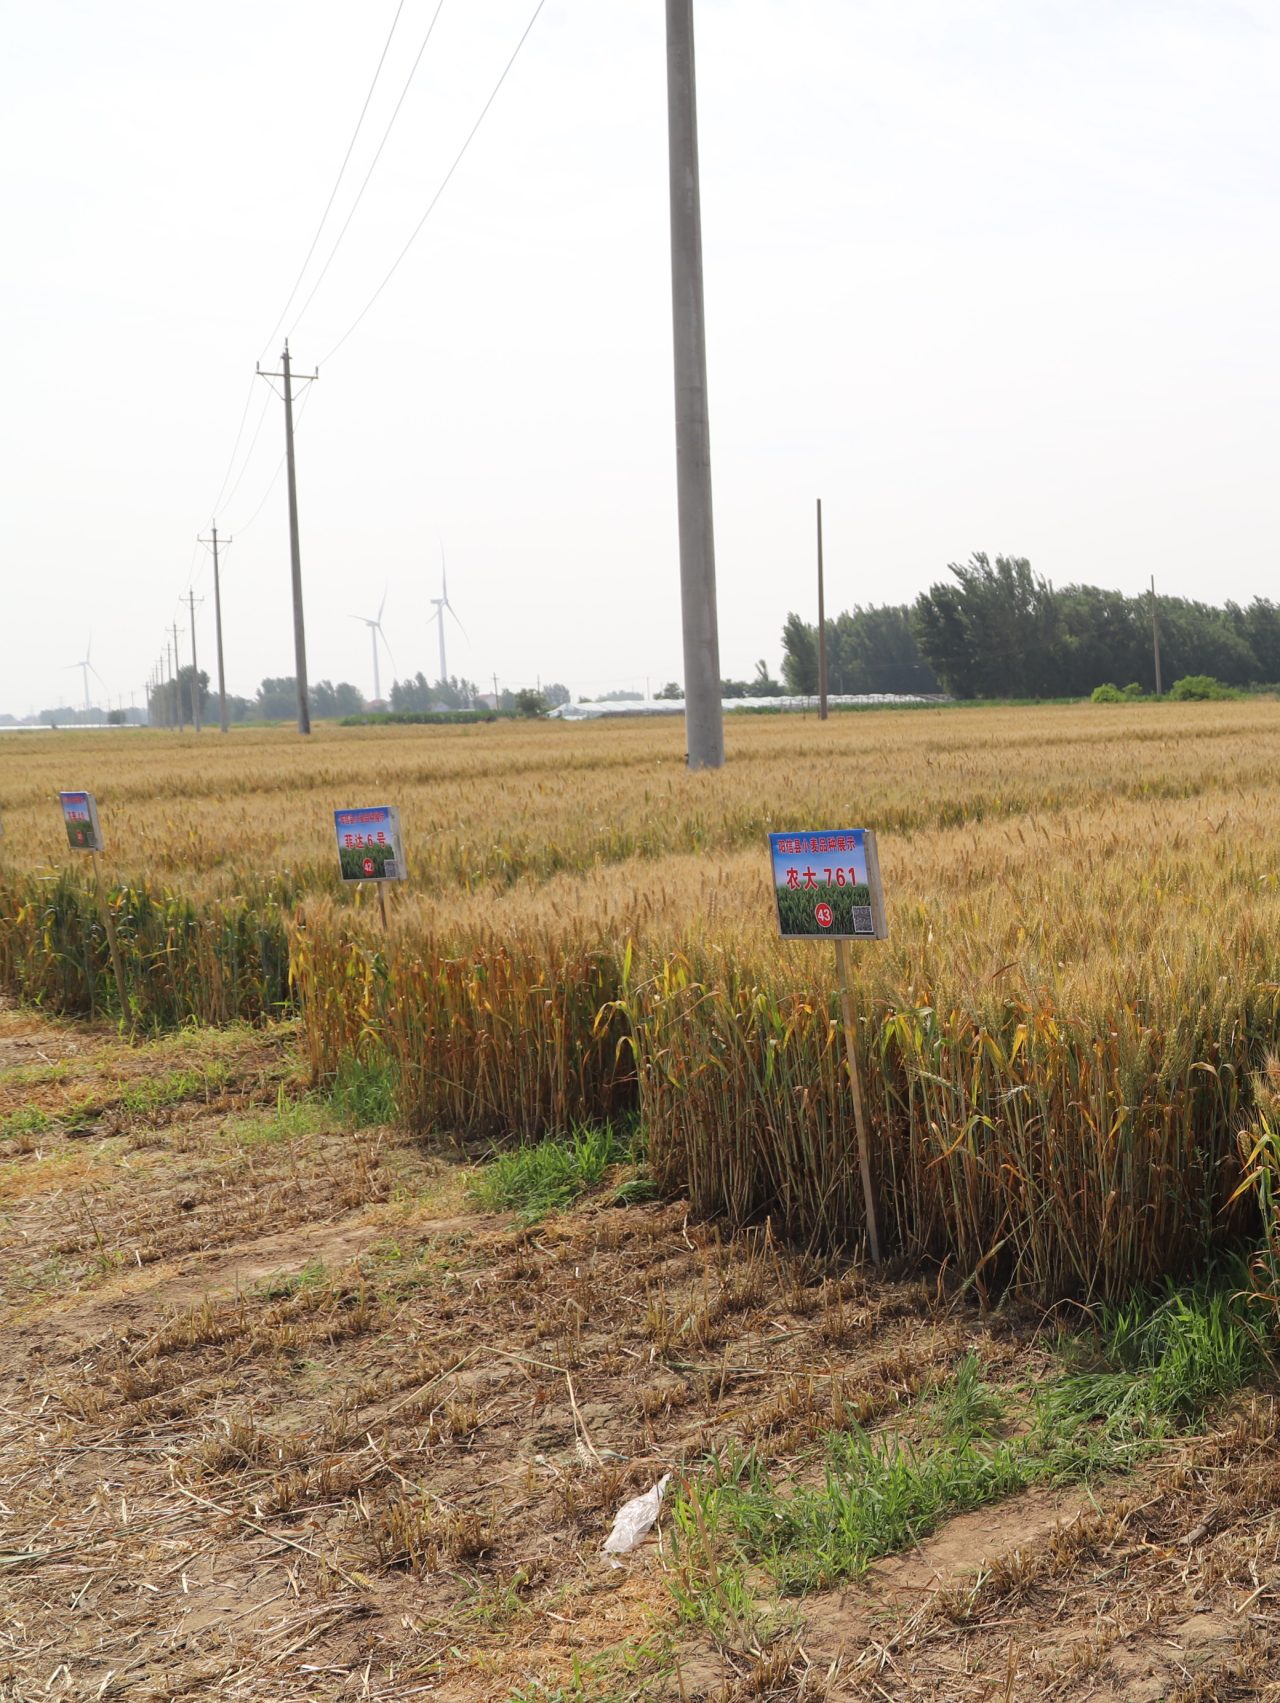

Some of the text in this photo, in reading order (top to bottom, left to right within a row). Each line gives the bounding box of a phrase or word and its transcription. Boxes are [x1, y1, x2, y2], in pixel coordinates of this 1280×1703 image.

[777, 836, 856, 854] 阳信县小麦品种展示
[817, 909, 831, 921] 43
